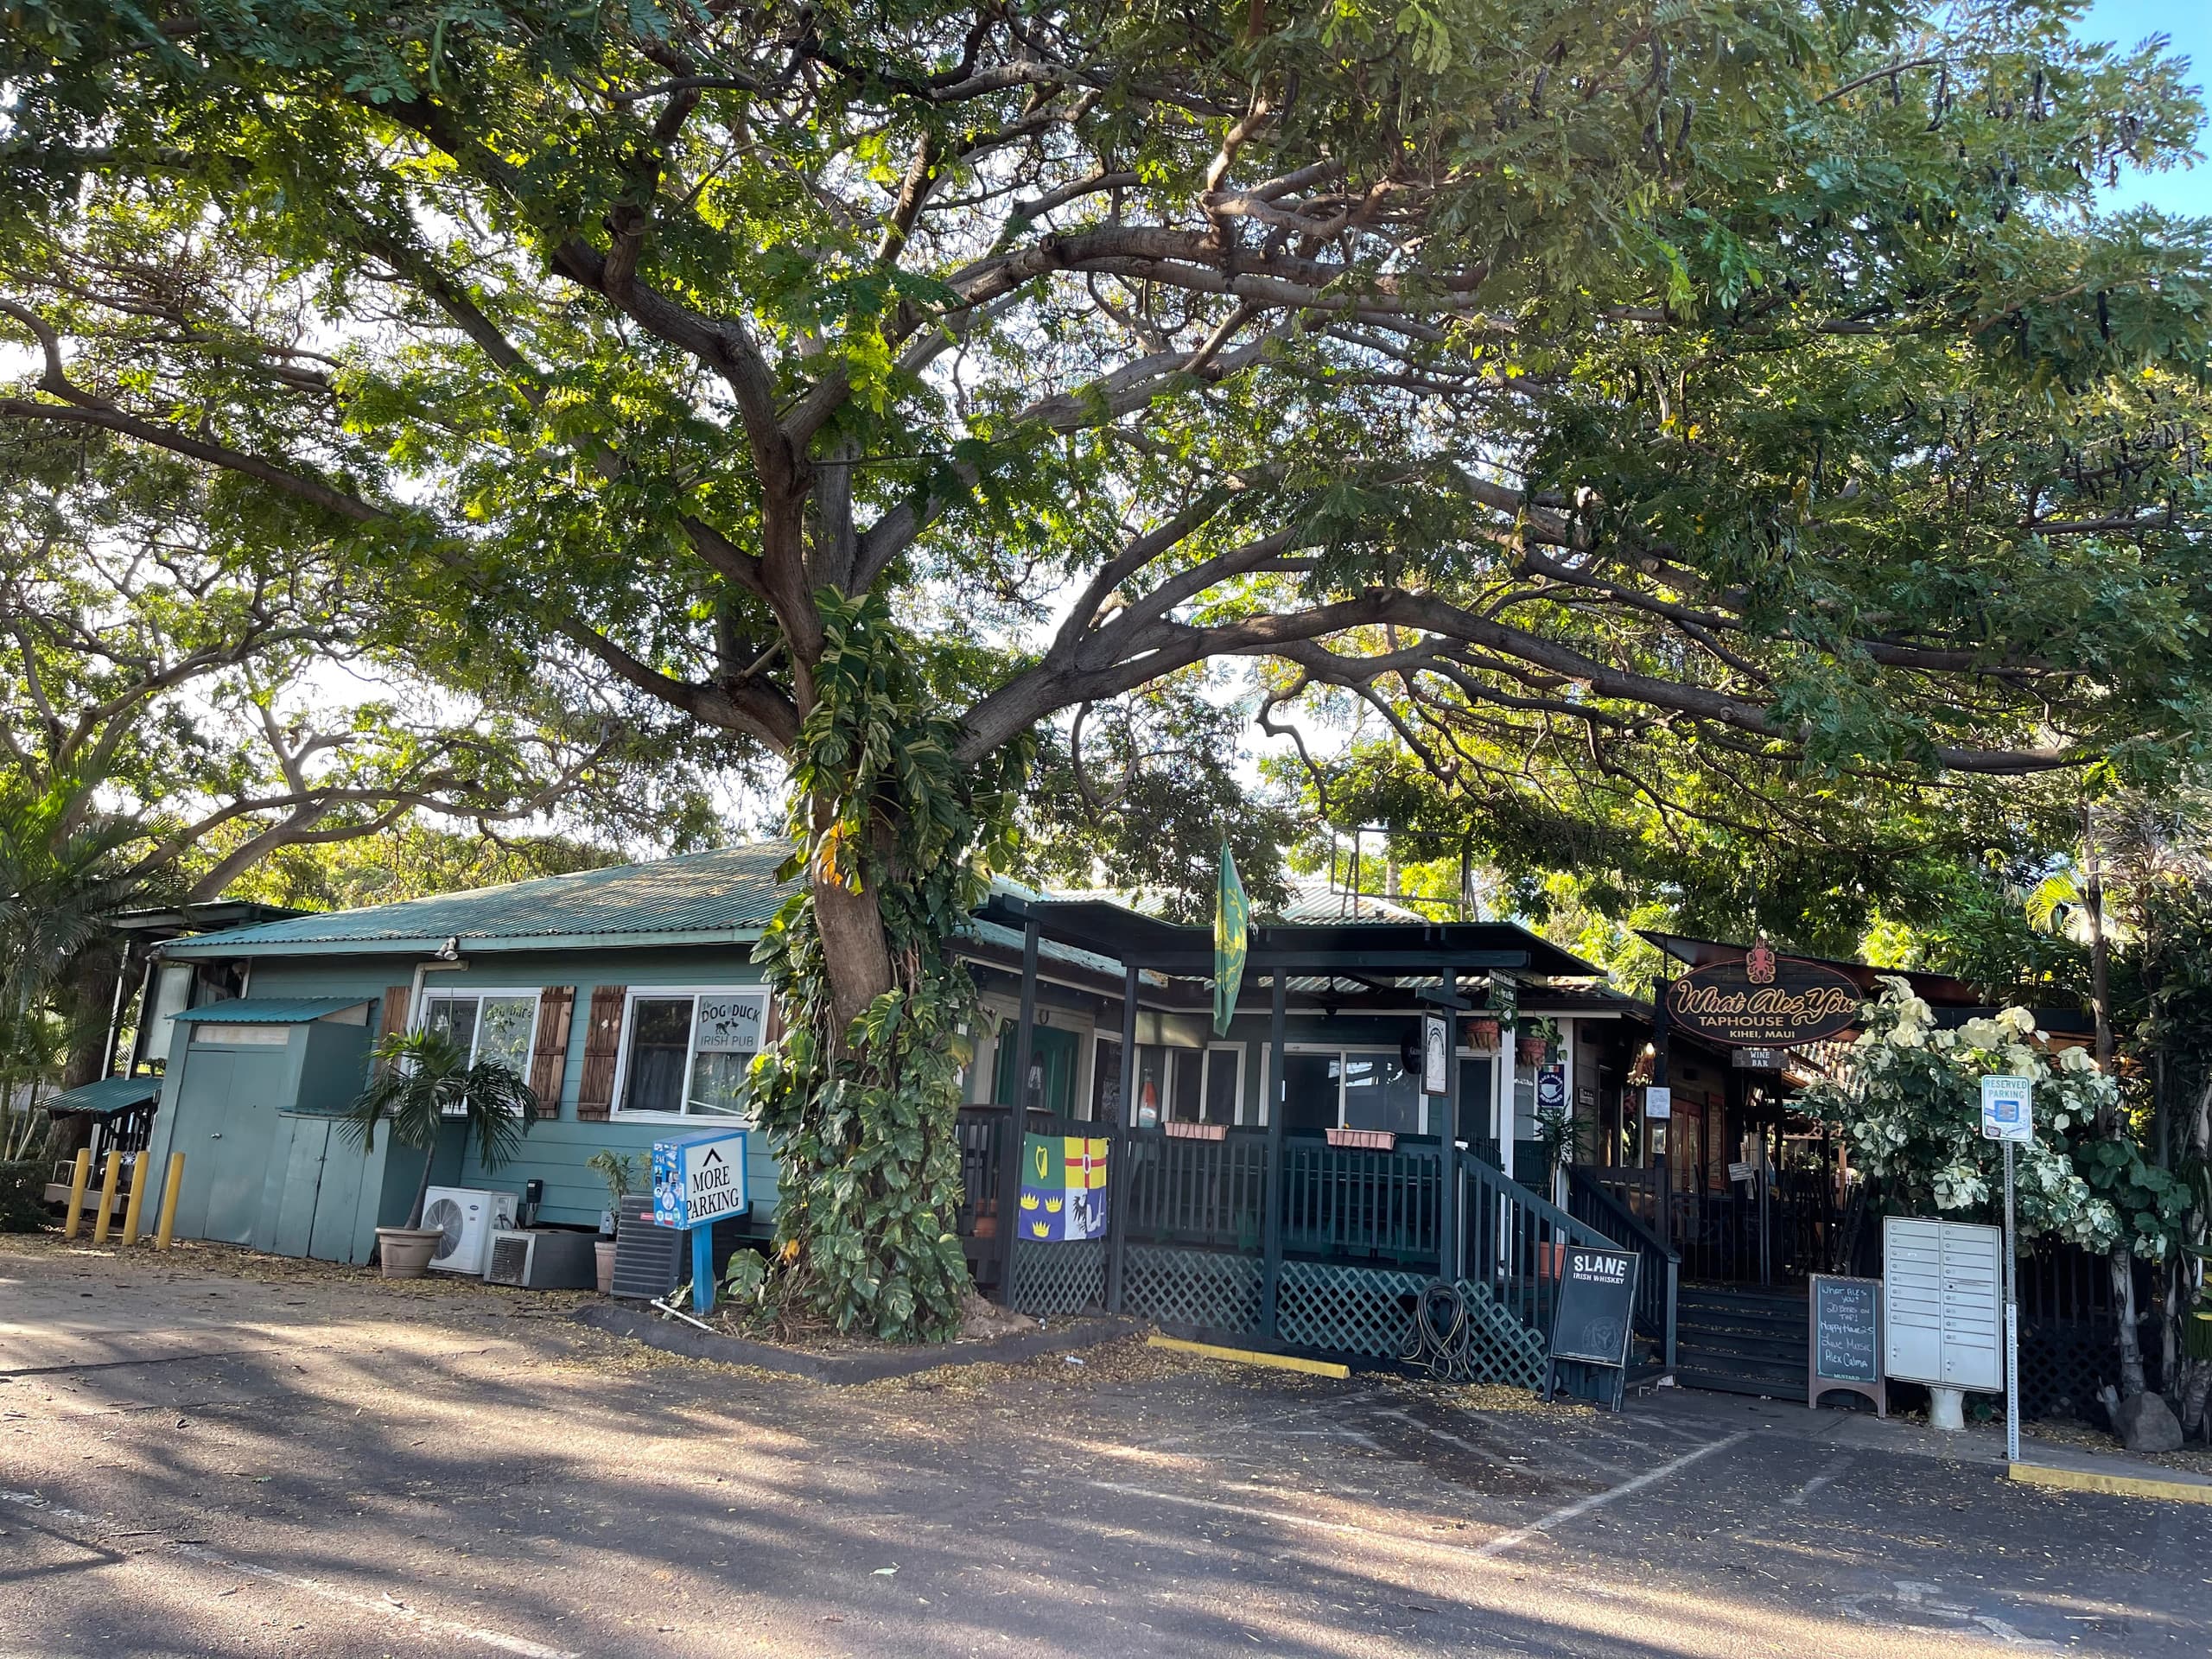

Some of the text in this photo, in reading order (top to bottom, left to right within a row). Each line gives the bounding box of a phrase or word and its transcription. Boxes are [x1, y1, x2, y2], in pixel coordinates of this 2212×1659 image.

[1677, 980, 1858, 1027] What Ales You
[702, 1004, 726, 1023] DOG
[732, 1004, 760, 1023] DUCK
[1699, 1016, 1784, 1027] TAPHOUSE
[1730, 1030, 1795, 1039] KIHEI, MAUI
[701, 1036, 754, 1046] IRISH PUB
[1750, 1051, 1770, 1059] WINE
[1986, 1079, 2027, 1089] RESERVED
[1988, 1090, 2024, 1099] PARKING
[693, 1166, 730, 1193] MORE
[687, 1188, 739, 1219] PARKING
[1573, 1255, 1627, 1277] SLANE
[1573, 1272, 1624, 1285] IRISH WHISKEY
